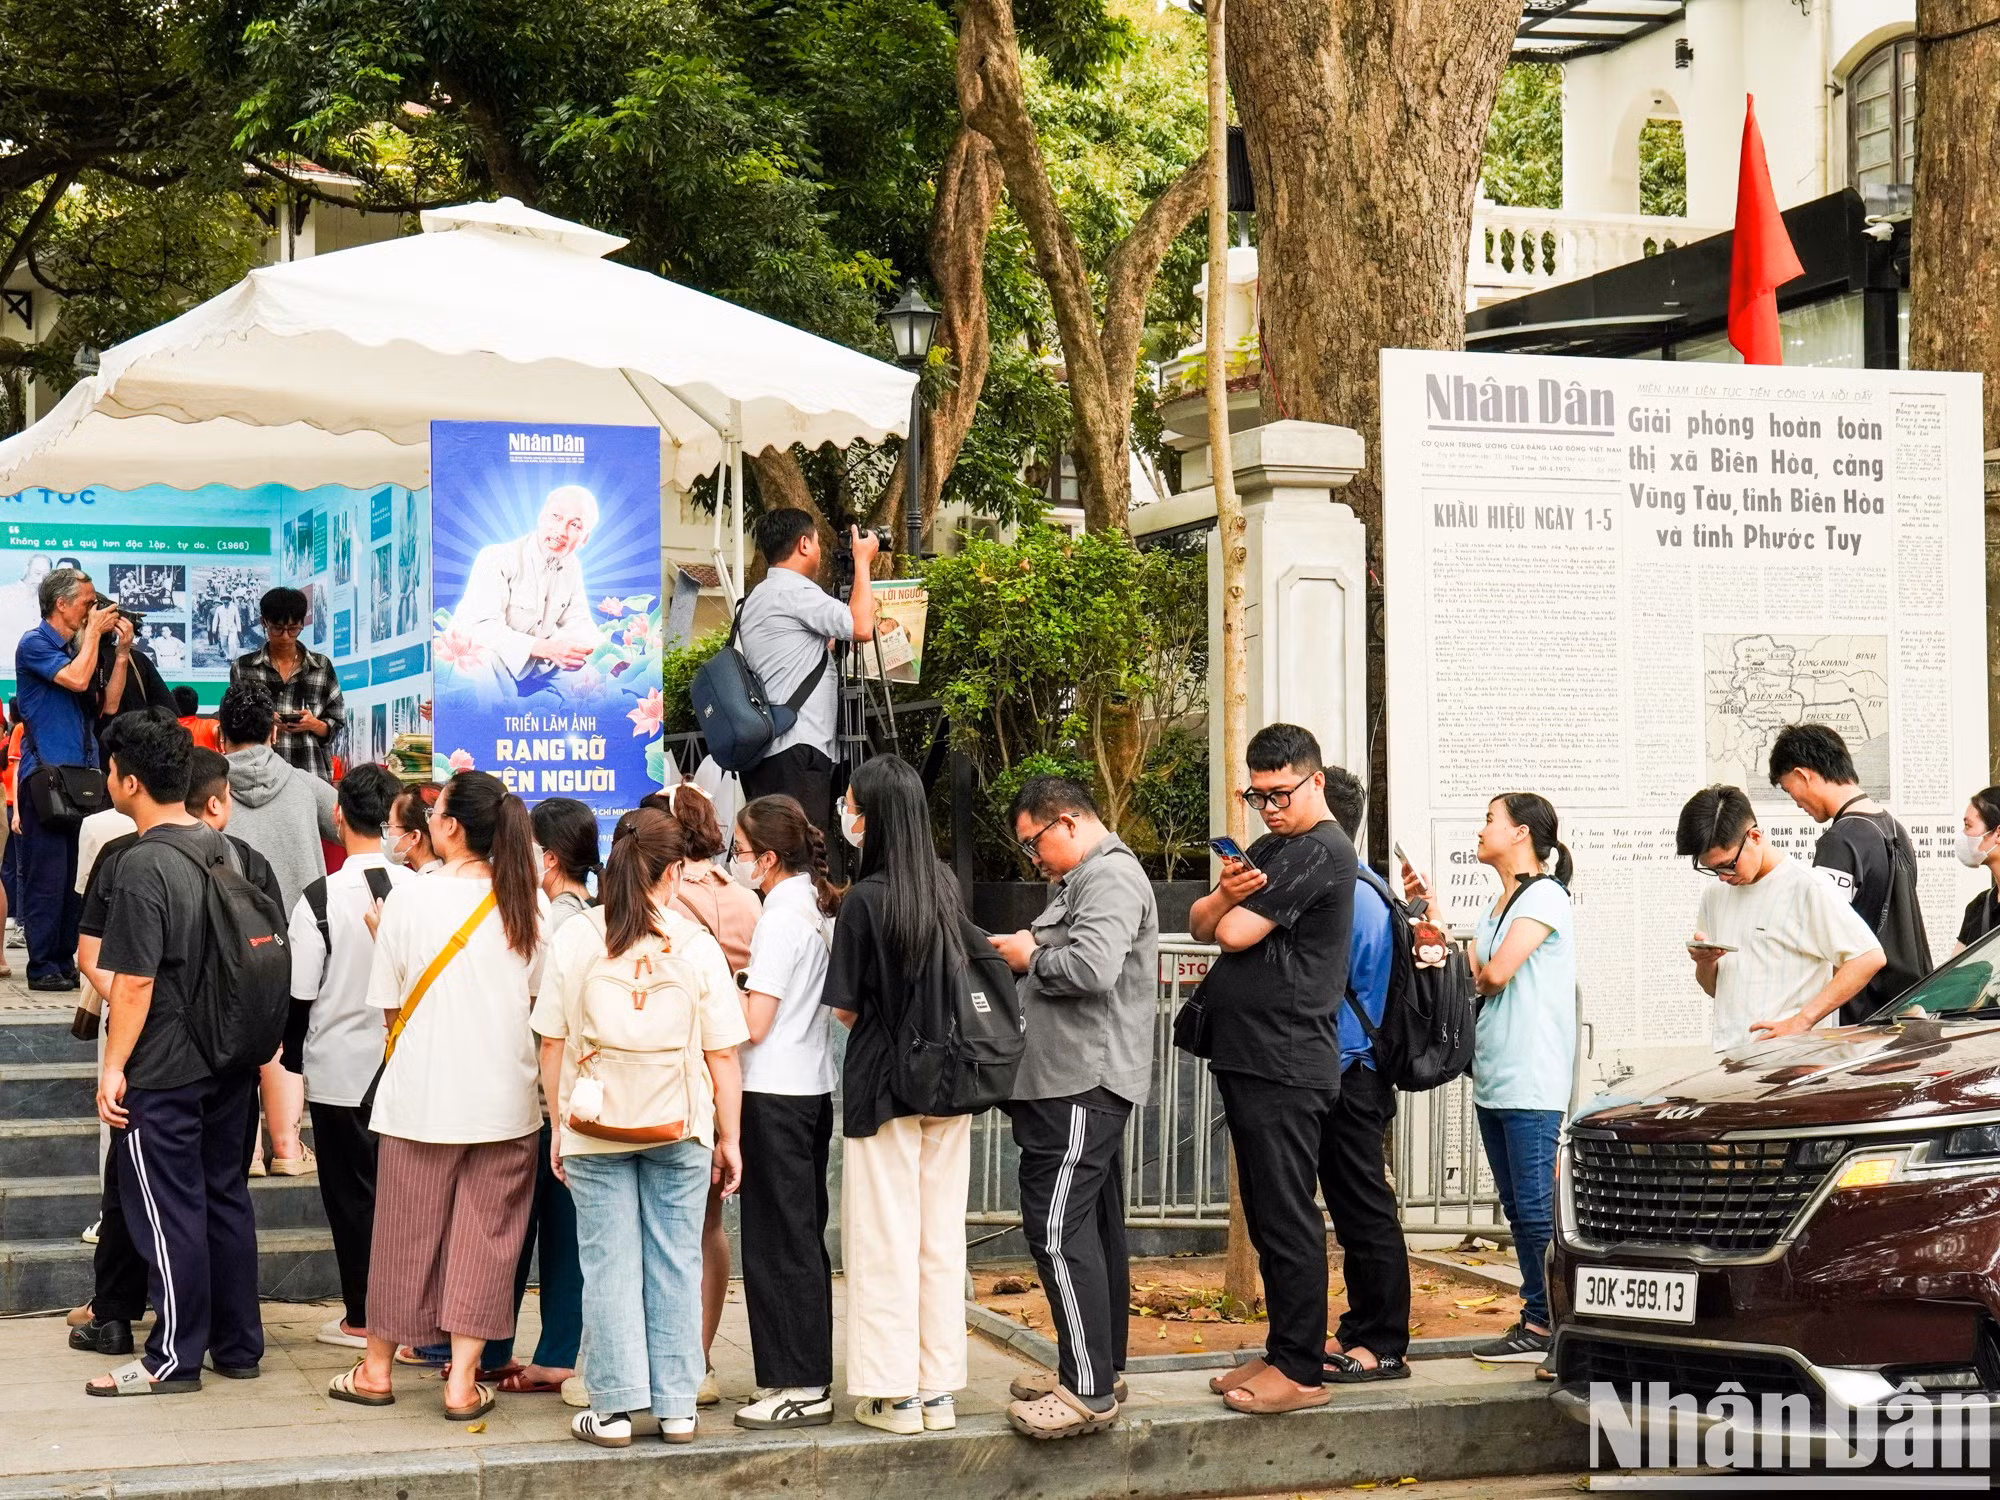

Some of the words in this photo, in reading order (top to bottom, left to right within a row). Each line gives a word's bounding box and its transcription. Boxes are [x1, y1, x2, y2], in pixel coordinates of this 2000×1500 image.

[1426, 373, 1529, 424] Nhân
[1538, 378, 1615, 427] Dân
[1628, 407, 1671, 434] Giải
[1688, 409, 1754, 440] phóng
[1769, 412, 1821, 439] hoàn
[1837, 415, 1883, 441] toàn
[508, 432, 551, 452] Nhân
[552, 433, 585, 452] Dân
[1434, 440, 1455, 448] QUAN
[1629, 445, 1655, 474] thị
[1669, 450, 1697, 471] xã
[1710, 447, 1757, 474] Biên
[1771, 449, 1819, 480] Hòa,
[1832, 453, 1884, 482] cảng
[1629, 483, 1686, 516] Vũng
[1693, 485, 1738, 516] Tàu,
[1743, 487, 1782, 513] tỉnh
[1790, 488, 1836, 514] Biên
[1843, 489, 1884, 515] Hòa
[1488, 503, 1525, 532] HIỆU
[1585, 508, 1612, 531] 1-5
[10, 537, 40, 551] Không
[45, 539, 57, 547] có
[217, 541, 250, 554] (1966)
[1656, 526, 1682, 547] và
[1693, 524, 1733, 549] tỉnh
[1744, 525, 1815, 550] Phước
[1826, 526, 1862, 556] Tuy
[882, 588, 896, 601] LỜI
[505, 712, 539, 732] TRIỂN
[543, 714, 568, 732] LÃM
[571, 712, 597, 732] ẢNH
[496, 738, 567, 764] RẠNG
[572, 734, 607, 761] RỠ
[541, 766, 616, 792] NGƯỜI
[1449, 849, 1478, 865] Giả
